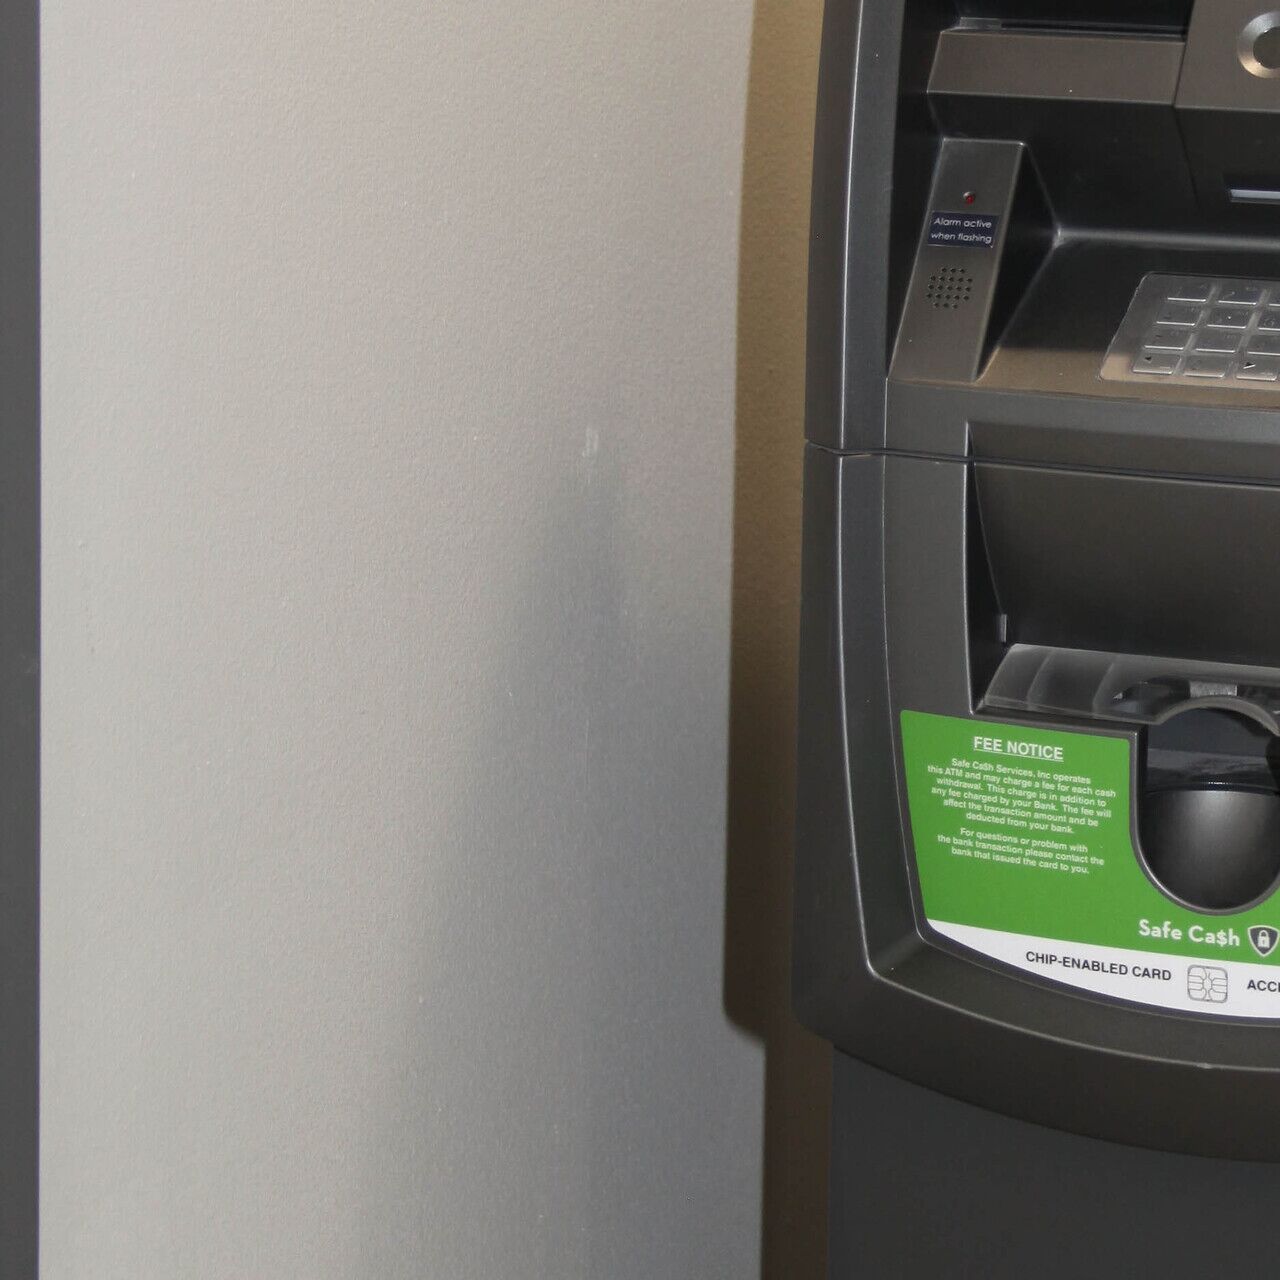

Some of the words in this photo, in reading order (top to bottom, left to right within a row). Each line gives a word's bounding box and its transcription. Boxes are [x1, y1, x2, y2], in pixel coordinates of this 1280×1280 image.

[933, 218, 961, 226] Alarm
[963, 219, 992, 228] active
[931, 232, 956, 240] when
[958, 233, 992, 244] flashing
[974, 736, 1003, 752] FEE
[1007, 741, 1063, 760] NOTICE
[927, 765, 943, 774] this
[944, 768, 963, 777] ATM
[965, 771, 981, 780] and
[983, 775, 1000, 784] may
[1003, 776, 1032, 788] charge
[1042, 781, 1055, 790] fee
[1057, 783, 1070, 791] for
[1072, 786, 1093, 795] each
[1095, 789, 1116, 797] cash
[952, 758, 970, 768] Safe
[1053, 773, 1091, 784] operates
[931, 787, 946, 797] any
[948, 788, 961, 797] fee
[963, 792, 998, 803] charged
[1012, 800, 1032, 808] your
[1063, 804, 1079, 814] The
[1081, 807, 1094, 816] fee
[1096, 809, 1112, 818] will
[987, 783, 1005, 794] This
[1007, 787, 1037, 799] charge
[1060, 795, 1095, 805] addition
[943, 798, 966, 808] affect
[968, 802, 982, 810] the
[984, 804, 1032, 817] transaction
[1033, 812, 1067, 822] amount
[1068, 816, 1086, 825] and
[1087, 818, 1099, 827] be
[966, 812, 1006, 824] deducted
[1007, 818, 1027, 827] from
[1029, 822, 1048, 830] your
[937, 834, 951, 844] the
[952, 837, 973, 847] bank
[975, 841, 1023, 854] transaction
[1025, 848, 1053, 858] please
[1056, 853, 1089, 863] contact
[1090, 856, 1104, 865] the
[960, 827, 974, 837] For
[976, 831, 1018, 843] questions
[1031, 839, 1067, 850] problem
[1069, 844, 1088, 853] with
[951, 846, 972, 857] bank
[974, 850, 991, 860] that
[993, 853, 1021, 864] issued
[1022, 857, 1036, 866] the
[1039, 860, 1058, 869] card
[1138, 919, 1182, 940] Safe
[1188, 925, 1240, 948] Ca$h
[1025, 951, 1129, 976] CHIP-ENABLED
[1132, 966, 1172, 982] CARD
